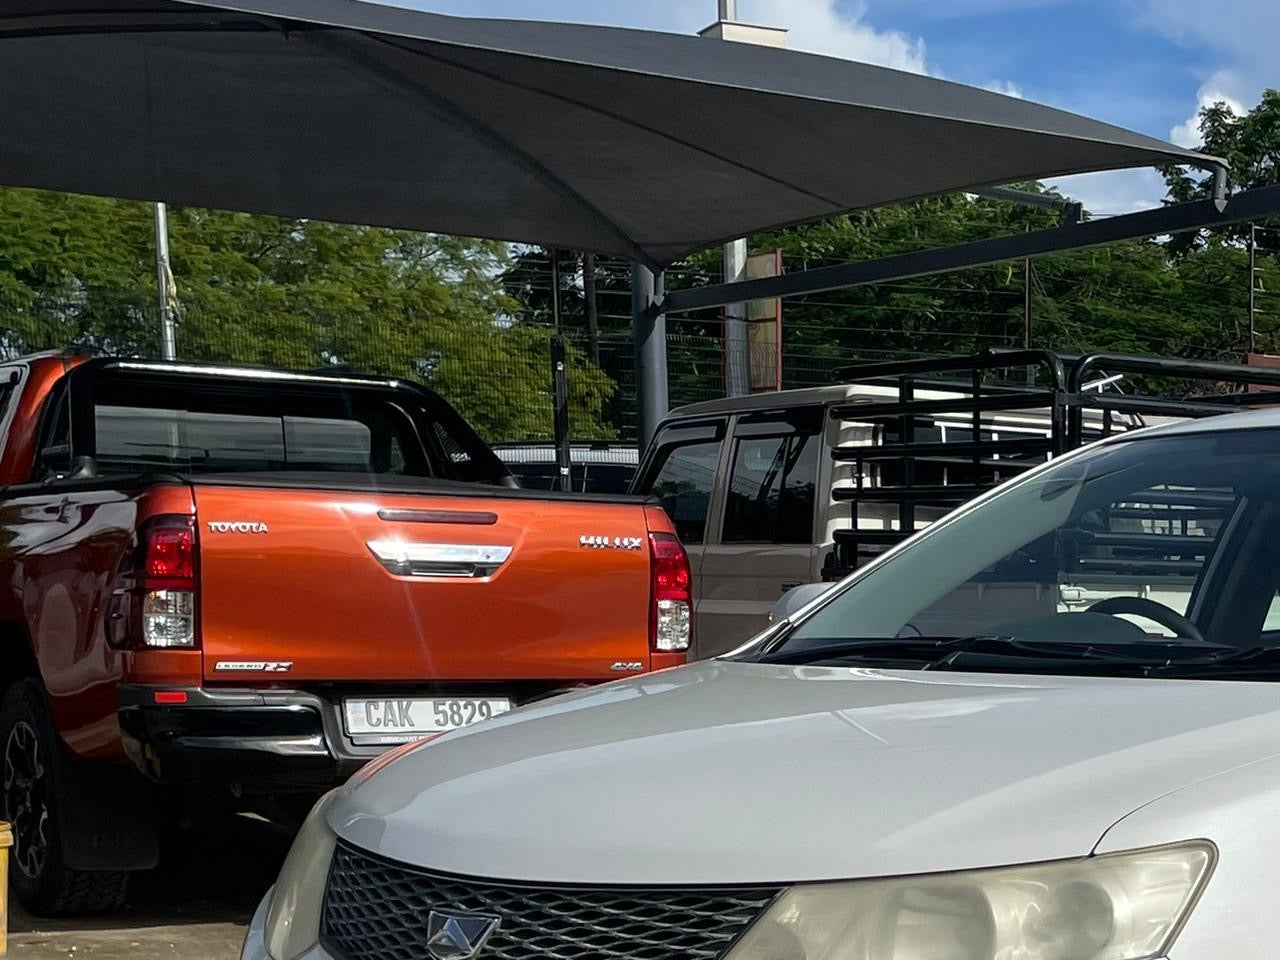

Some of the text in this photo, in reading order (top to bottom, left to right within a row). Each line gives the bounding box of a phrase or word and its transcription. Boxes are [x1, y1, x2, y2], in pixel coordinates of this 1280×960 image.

[207, 521, 269, 534] TOYOTA
[580, 535, 642, 550] HILUX
[365, 700, 493, 728] CAK 5829
